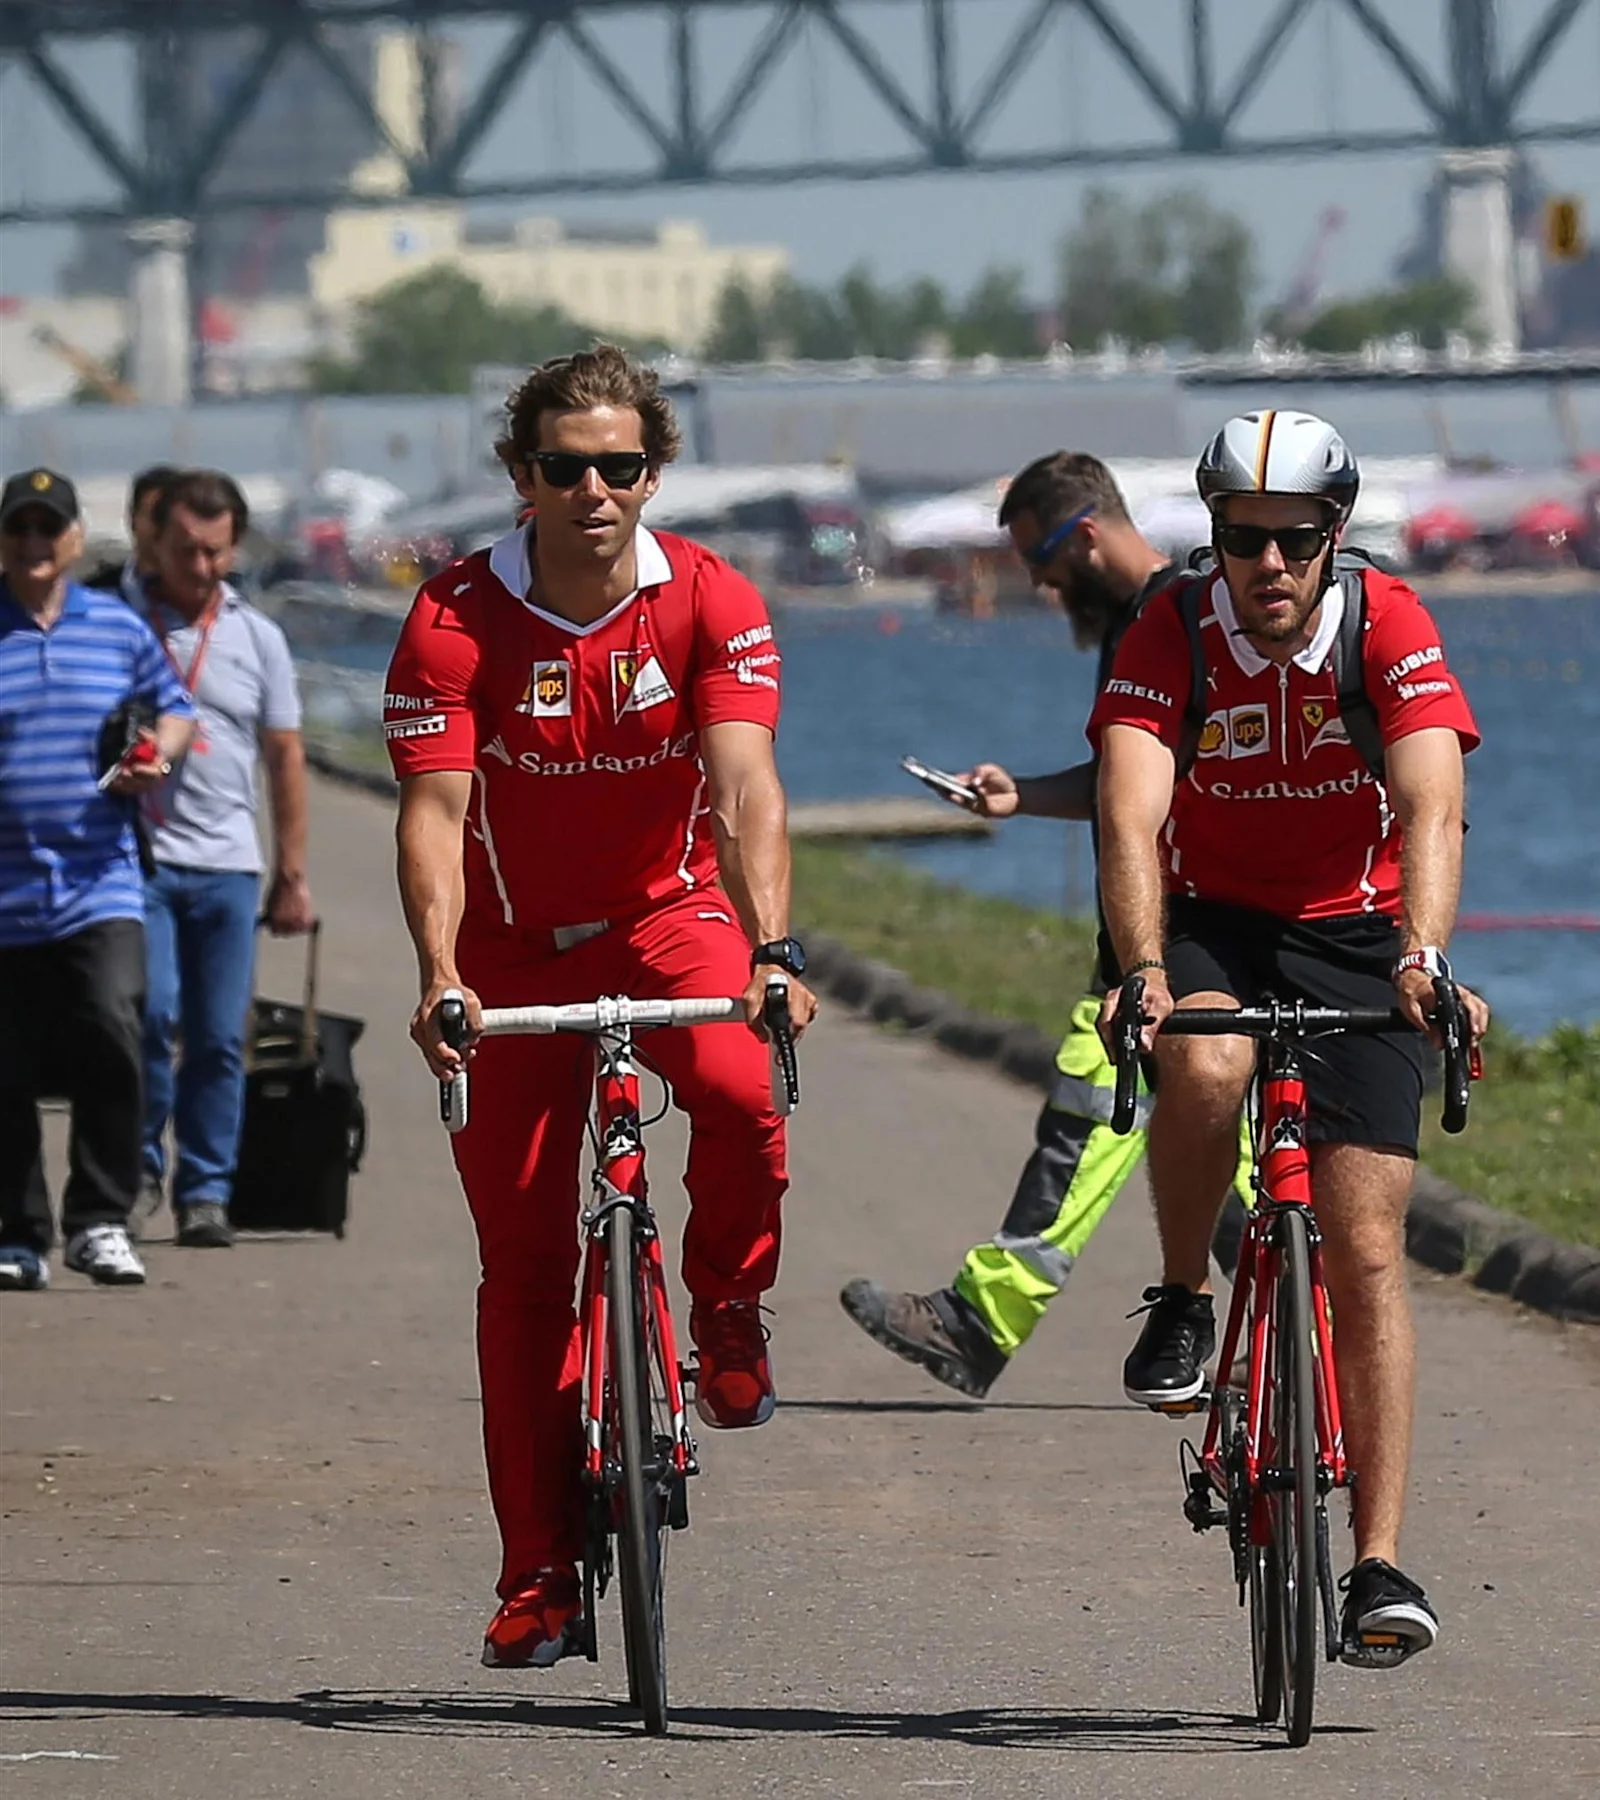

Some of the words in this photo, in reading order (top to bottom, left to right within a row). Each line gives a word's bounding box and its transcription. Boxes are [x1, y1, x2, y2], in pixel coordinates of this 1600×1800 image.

[726, 624, 772, 654] HUBLO
[1383, 646, 1443, 686] HUBLOT
[538, 680, 564, 702] ups
[1234, 722, 1263, 745] ups
[518, 731, 694, 776] Santander
